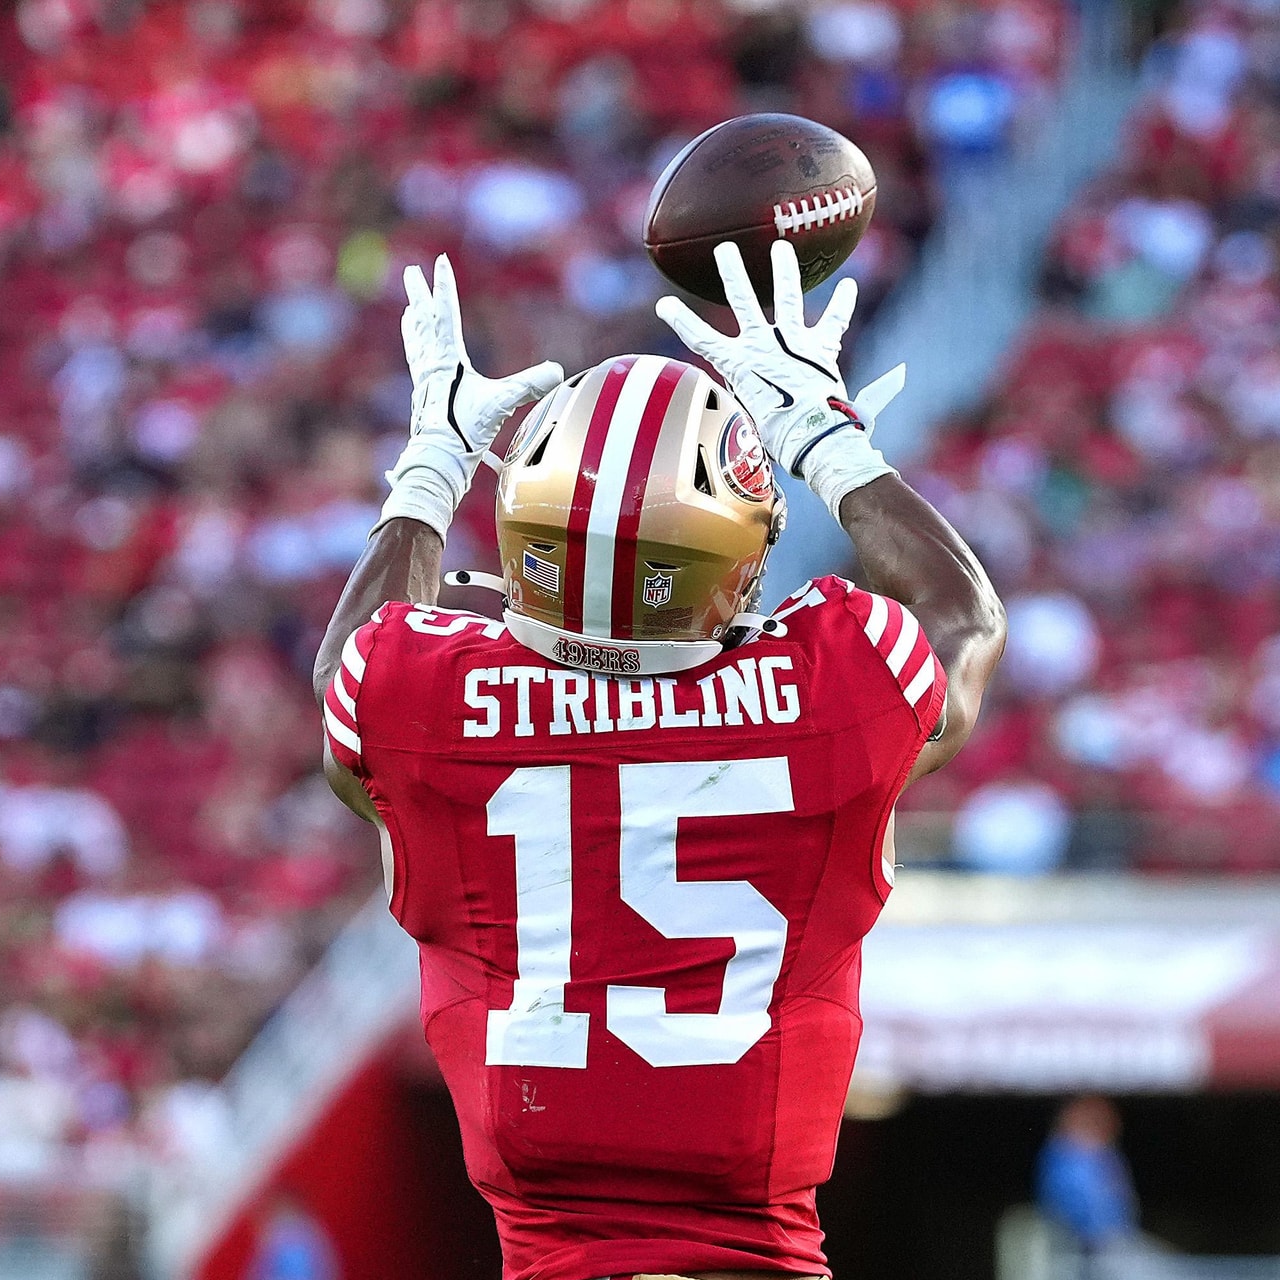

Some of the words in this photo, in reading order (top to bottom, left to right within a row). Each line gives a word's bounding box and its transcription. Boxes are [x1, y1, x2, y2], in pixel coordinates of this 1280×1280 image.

[646, 588, 668, 603] NFL
[552, 636, 641, 674] 49ERS
[462, 655, 801, 738] STRIBLING
[485, 756, 796, 1069] 15
